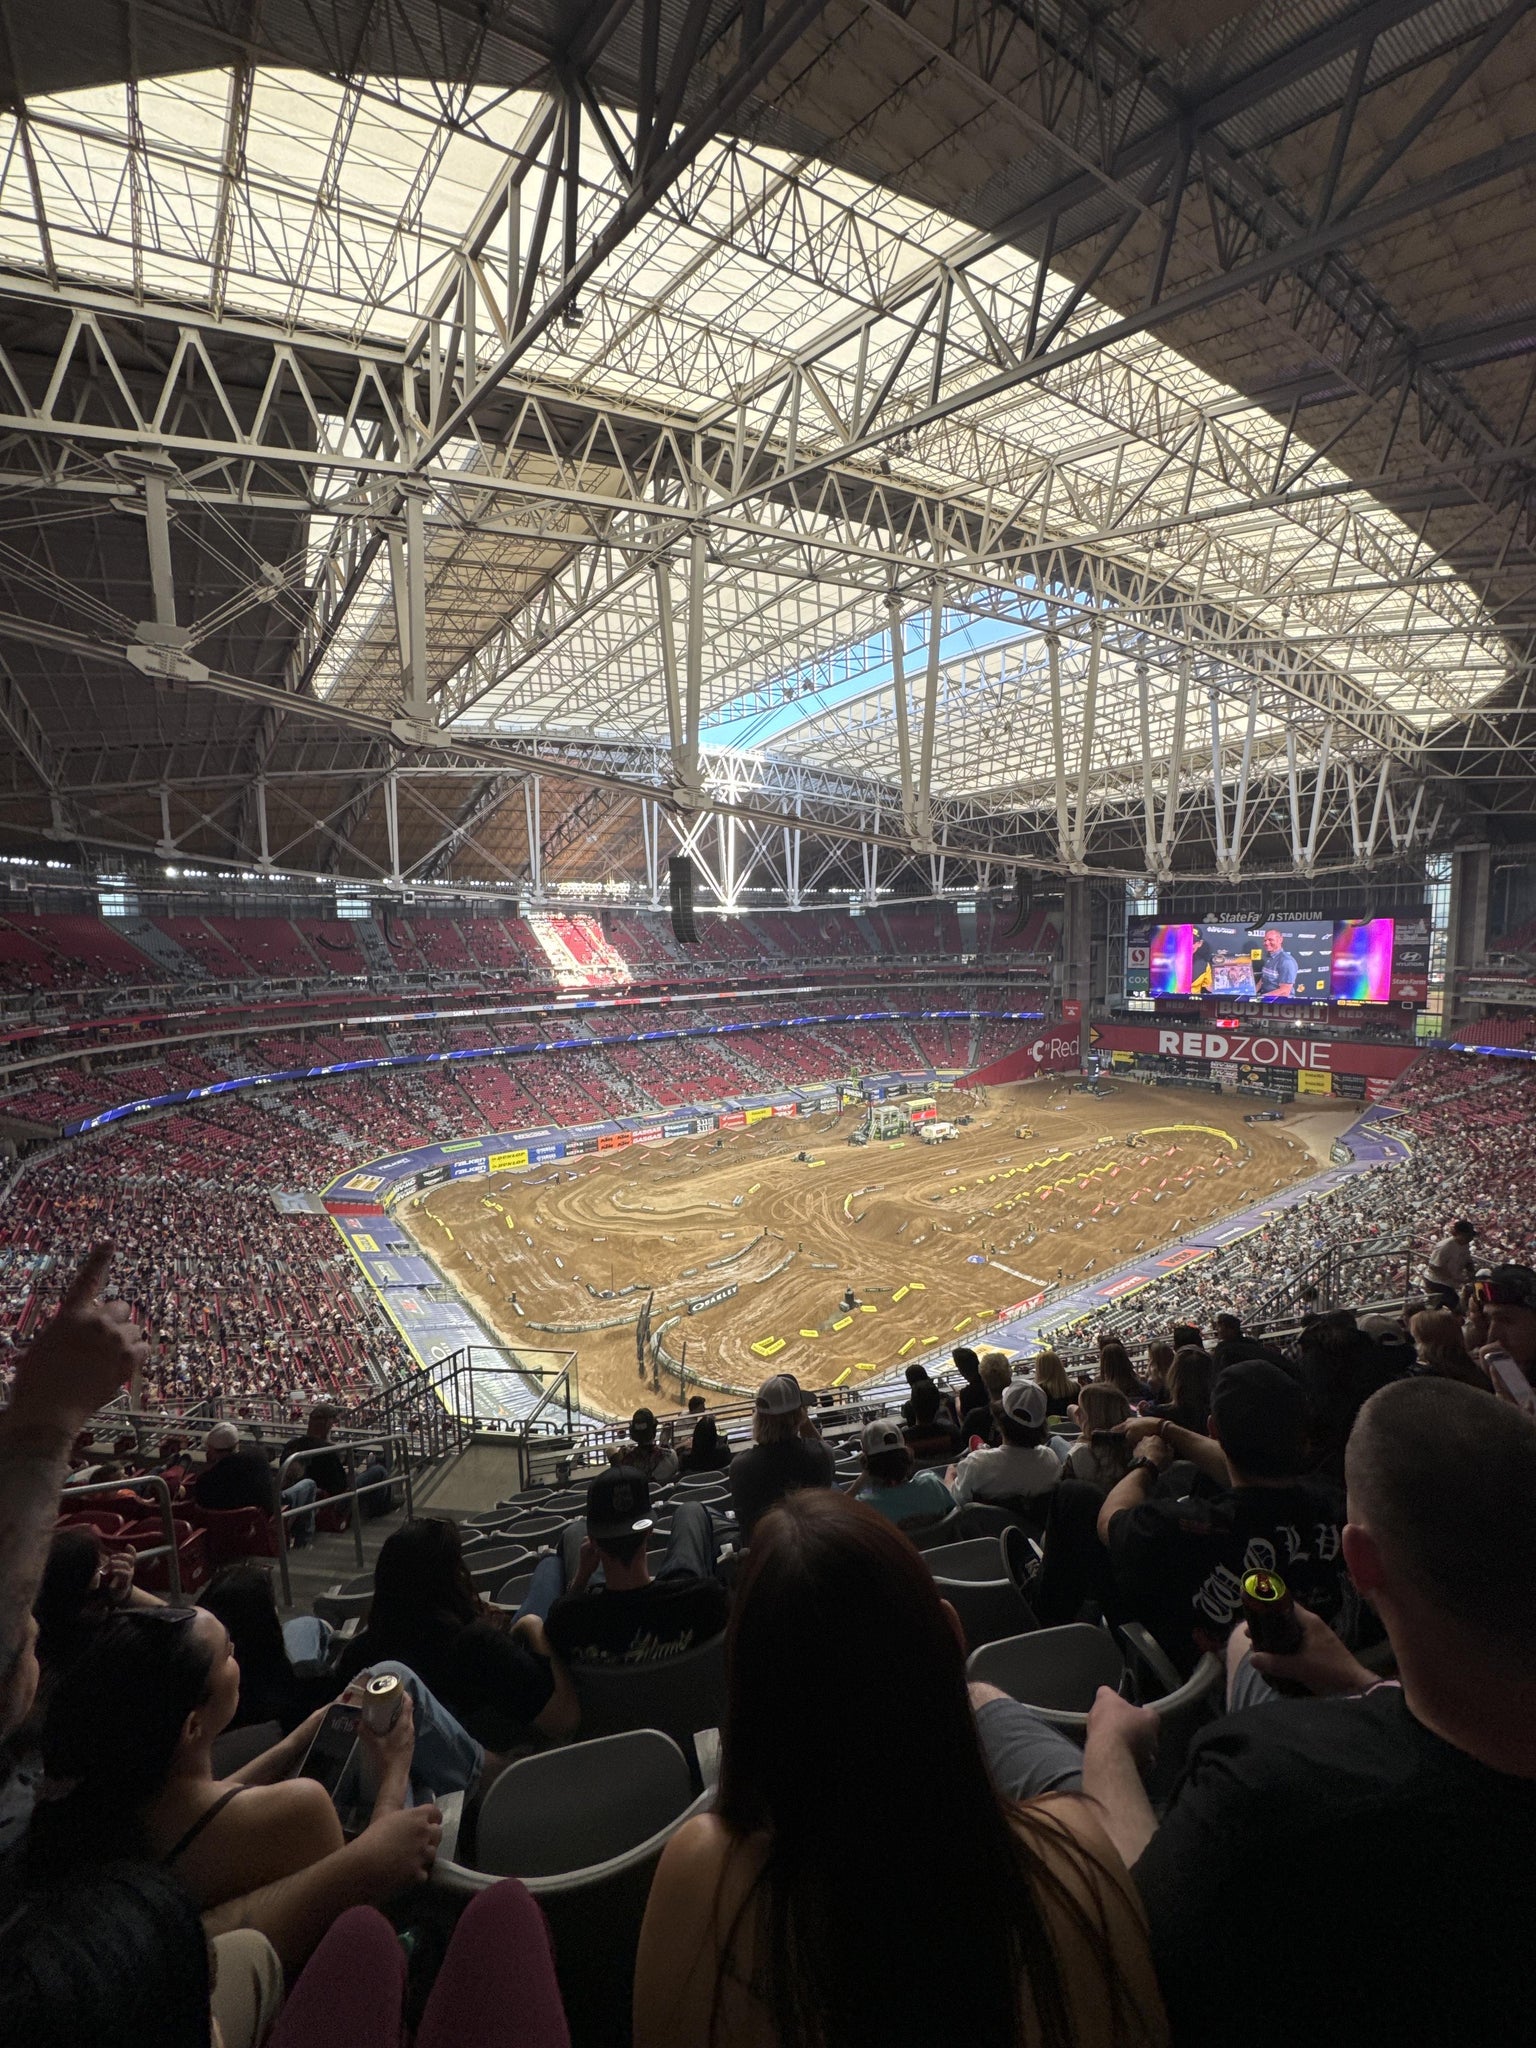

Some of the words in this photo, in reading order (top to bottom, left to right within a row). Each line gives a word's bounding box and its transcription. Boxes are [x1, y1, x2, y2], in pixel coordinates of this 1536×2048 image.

[1219, 911, 1276, 923] StateFam
[1276, 911, 1323, 921] STADIUM
[1128, 976, 1149, 984] COX
[1218, 1001, 1260, 1016] BUD
[1262, 1004, 1323, 1020] LIGHT
[1050, 1035, 1080, 1059] Red
[1158, 1029, 1332, 1070] REDZONE
[632, 1126, 662, 1137] GASGAS
[632, 1133, 663, 1144] GASGAS
[497, 1151, 526, 1161] DUNLOP
[454, 1157, 486, 1168] FALKEN
[498, 1159, 526, 1168] DUNLOP
[454, 1165, 487, 1176] FALKEN
[703, 1285, 738, 1306] OAKLEY
